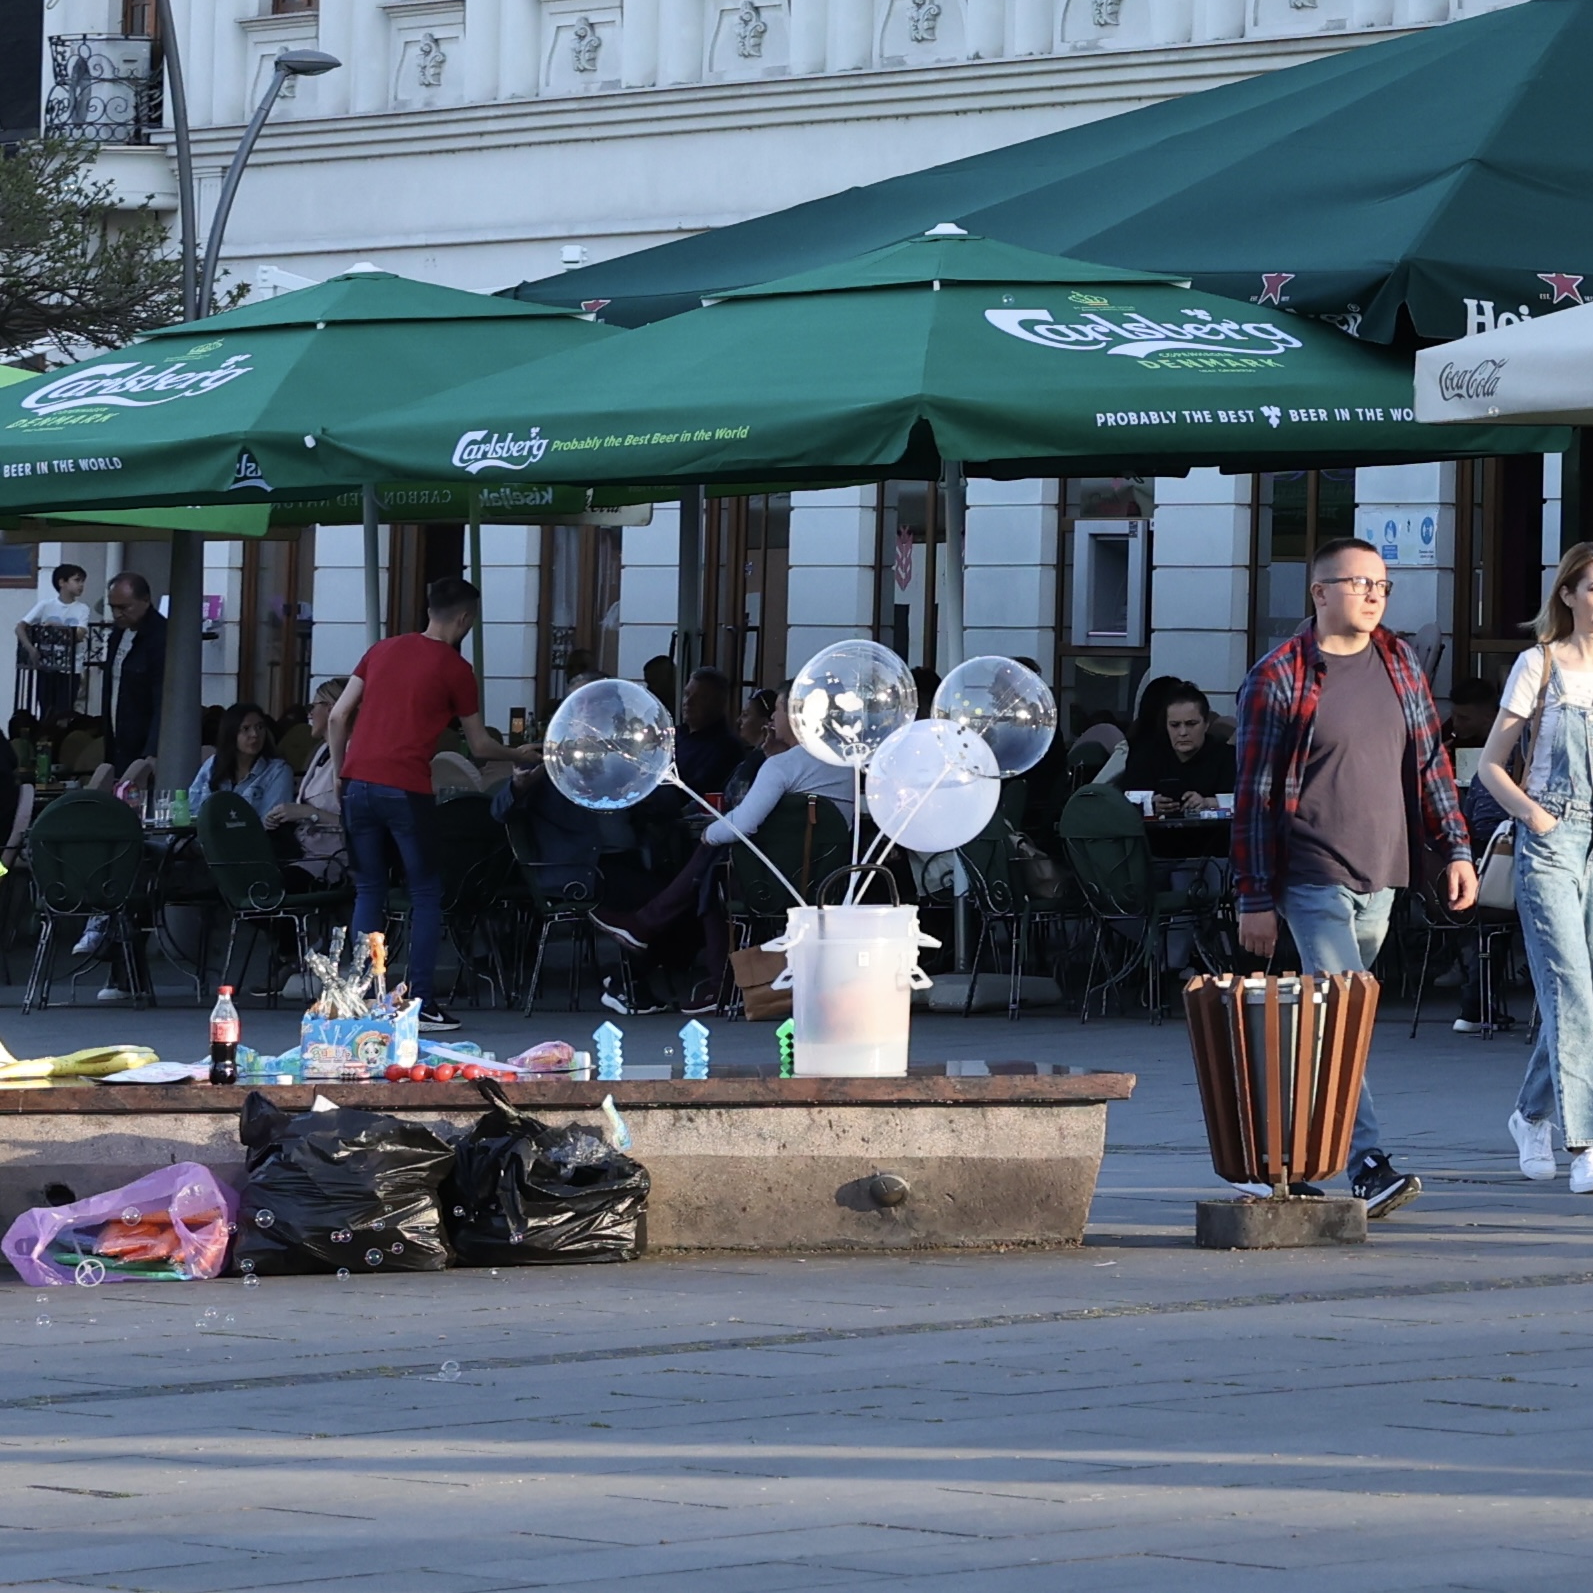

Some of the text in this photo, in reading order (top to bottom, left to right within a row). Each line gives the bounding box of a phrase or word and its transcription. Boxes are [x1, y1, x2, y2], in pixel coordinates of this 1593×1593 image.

[984, 308, 1303, 359] Carlsberg
[1137, 358, 1285, 369] DENMARK
[1440, 359, 1509, 401] Coca-Cola
[21, 355, 253, 416] Carlsberg
[1096, 408, 1414, 427] PROBABLY THE BEST BEER IN THE WO
[452, 427, 549, 475] Carlsberg
[550, 425, 750, 451] Probably the Best Beer in the World
[3, 457, 122, 478] BEER IN THE WORLD
